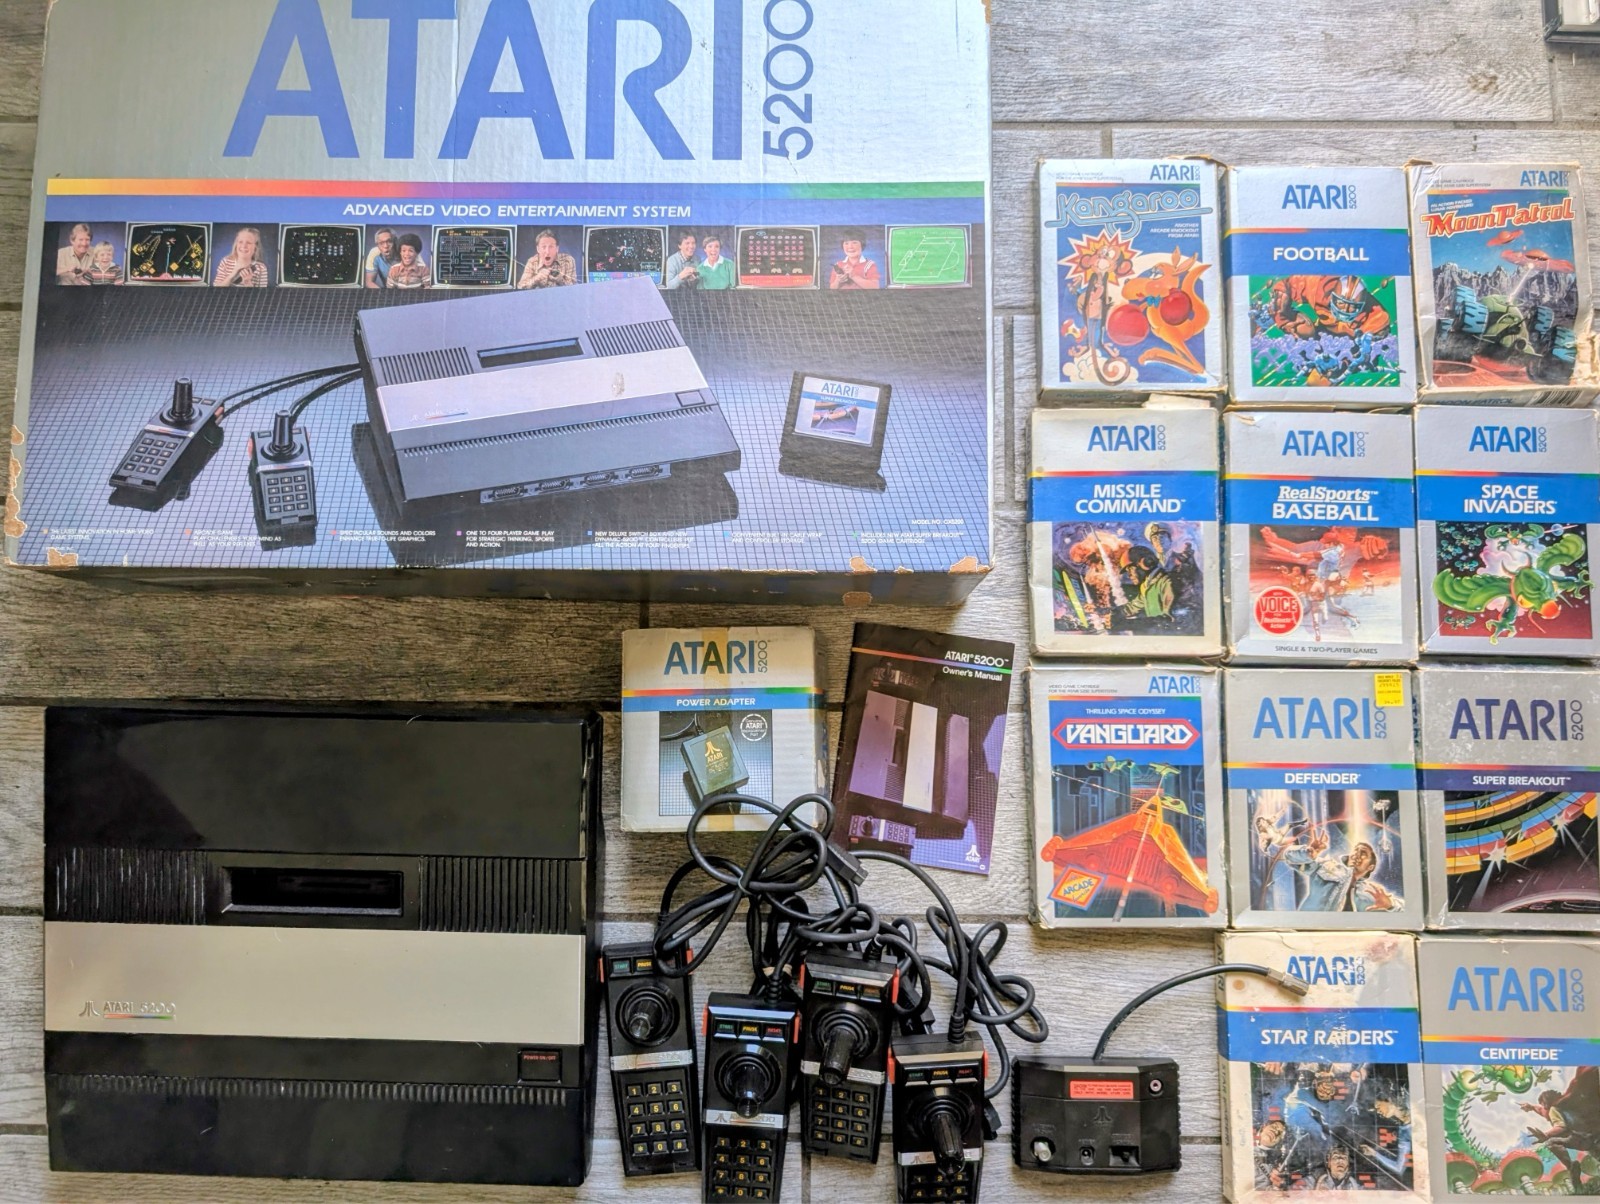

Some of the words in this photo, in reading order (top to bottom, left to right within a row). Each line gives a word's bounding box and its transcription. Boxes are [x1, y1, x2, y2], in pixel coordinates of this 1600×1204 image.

[223, 0, 742, 160] ATARI
[763, 0, 814, 160] 5200
[1150, 164, 1194, 181] ATARI
[1520, 170, 1562, 187] ATARI
[1282, 184, 1348, 210] ATARI
[1348, 184, 1357, 210] 5200
[342, 204, 435, 216] ADVANCED
[440, 205, 491, 217] VIDEO
[498, 206, 627, 218] ENTERTAINMENT
[632, 206, 691, 218] SYSTEM
[1044, 189, 1213, 240] Kangaroo
[1273, 247, 1370, 262] FOOTBALL
[821, 382, 854, 398] ATARI
[1088, 425, 1156, 452] ATARI
[1157, 424, 1166, 450] 5200
[1282, 430, 1355, 458] ATARI
[1357, 431, 1366, 458] 5200
[1469, 426, 1537, 452] ATARI
[1538, 426, 1547, 452] 5200
[1093, 484, 1162, 498] MISSILE
[1481, 484, 1539, 500] SPACE
[1075, 499, 1182, 514] COMMAND
[1272, 502, 1380, 522] BASEBALL
[1464, 499, 1556, 514] INVADERS
[1260, 597, 1298, 612] VOICE
[664, 640, 754, 675] ATARI
[758, 640, 768, 673] 5200
[944, 650, 971, 662] ATARI
[974, 656, 1005, 667] 5200
[942, 666, 973, 678] Owner's
[974, 671, 1002, 682] Manual
[1149, 676, 1194, 693] ATARI
[713, 698, 756, 706] ADAPTER
[1252, 697, 1372, 740] ATARI
[1450, 698, 1568, 741] ATARI
[1570, 700, 1584, 741] 5200
[1066, 724, 1193, 744] VANGUARD
[1284, 772, 1359, 785] DEFENDER
[1472, 776, 1506, 786] SUPER
[1508, 776, 1566, 787] BREAKOUT
[1064, 878, 1094, 896] ARCADE
[1216, 943, 1225, 991] ATRI
[1287, 956, 1356, 986] ATARI
[1448, 966, 1568, 1012] ATARI
[1570, 968, 1585, 1012] 5200
[103, 1001, 134, 1012] ATARI
[140, 1002, 176, 1014] 5200
[1260, 1029, 1308, 1045] STAR
[1314, 1029, 1394, 1046] RAIDERS
[1480, 1047, 1558, 1061] CENTIPEDE
